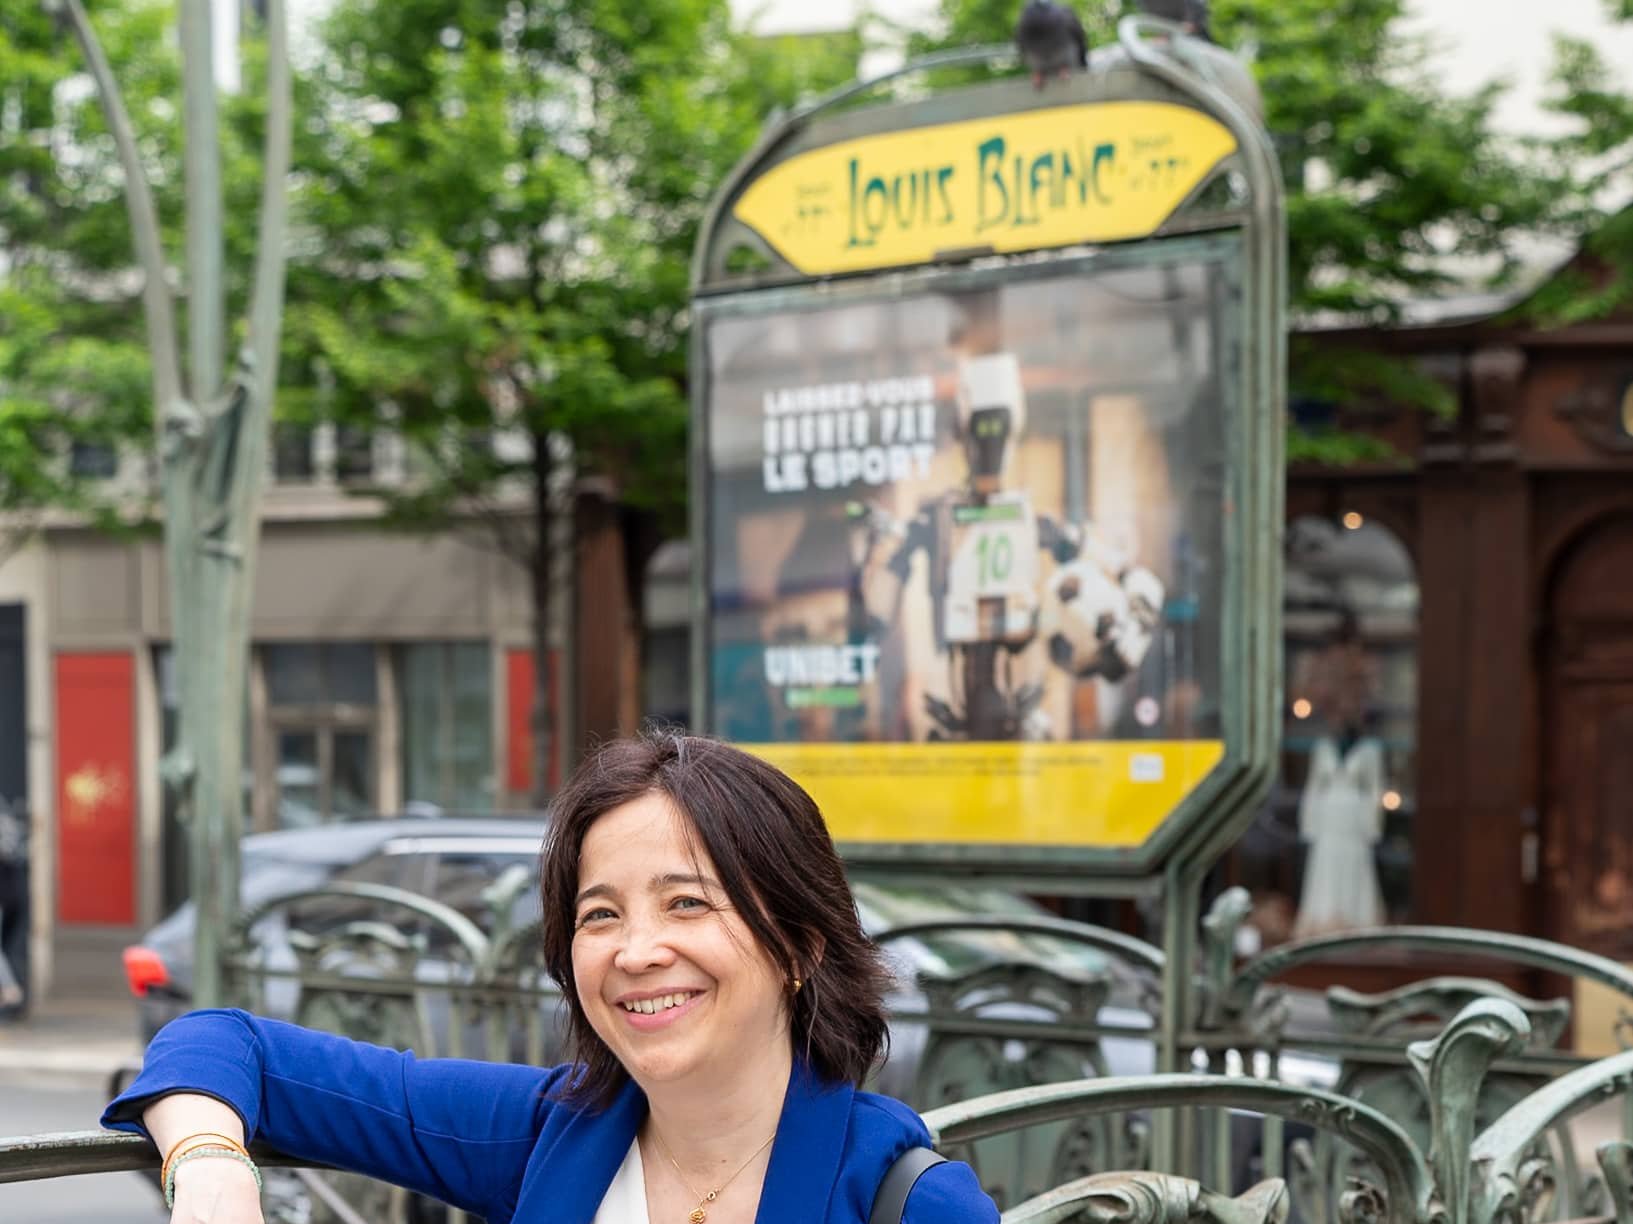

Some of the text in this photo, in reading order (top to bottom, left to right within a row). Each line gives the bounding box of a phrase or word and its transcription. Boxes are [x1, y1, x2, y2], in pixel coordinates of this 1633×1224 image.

[846, 135, 1115, 247] LOUIS BLANC
[763, 444, 935, 492] LE SPORT
[976, 534, 1012, 588] 10
[764, 644, 879, 687] UNIBET
